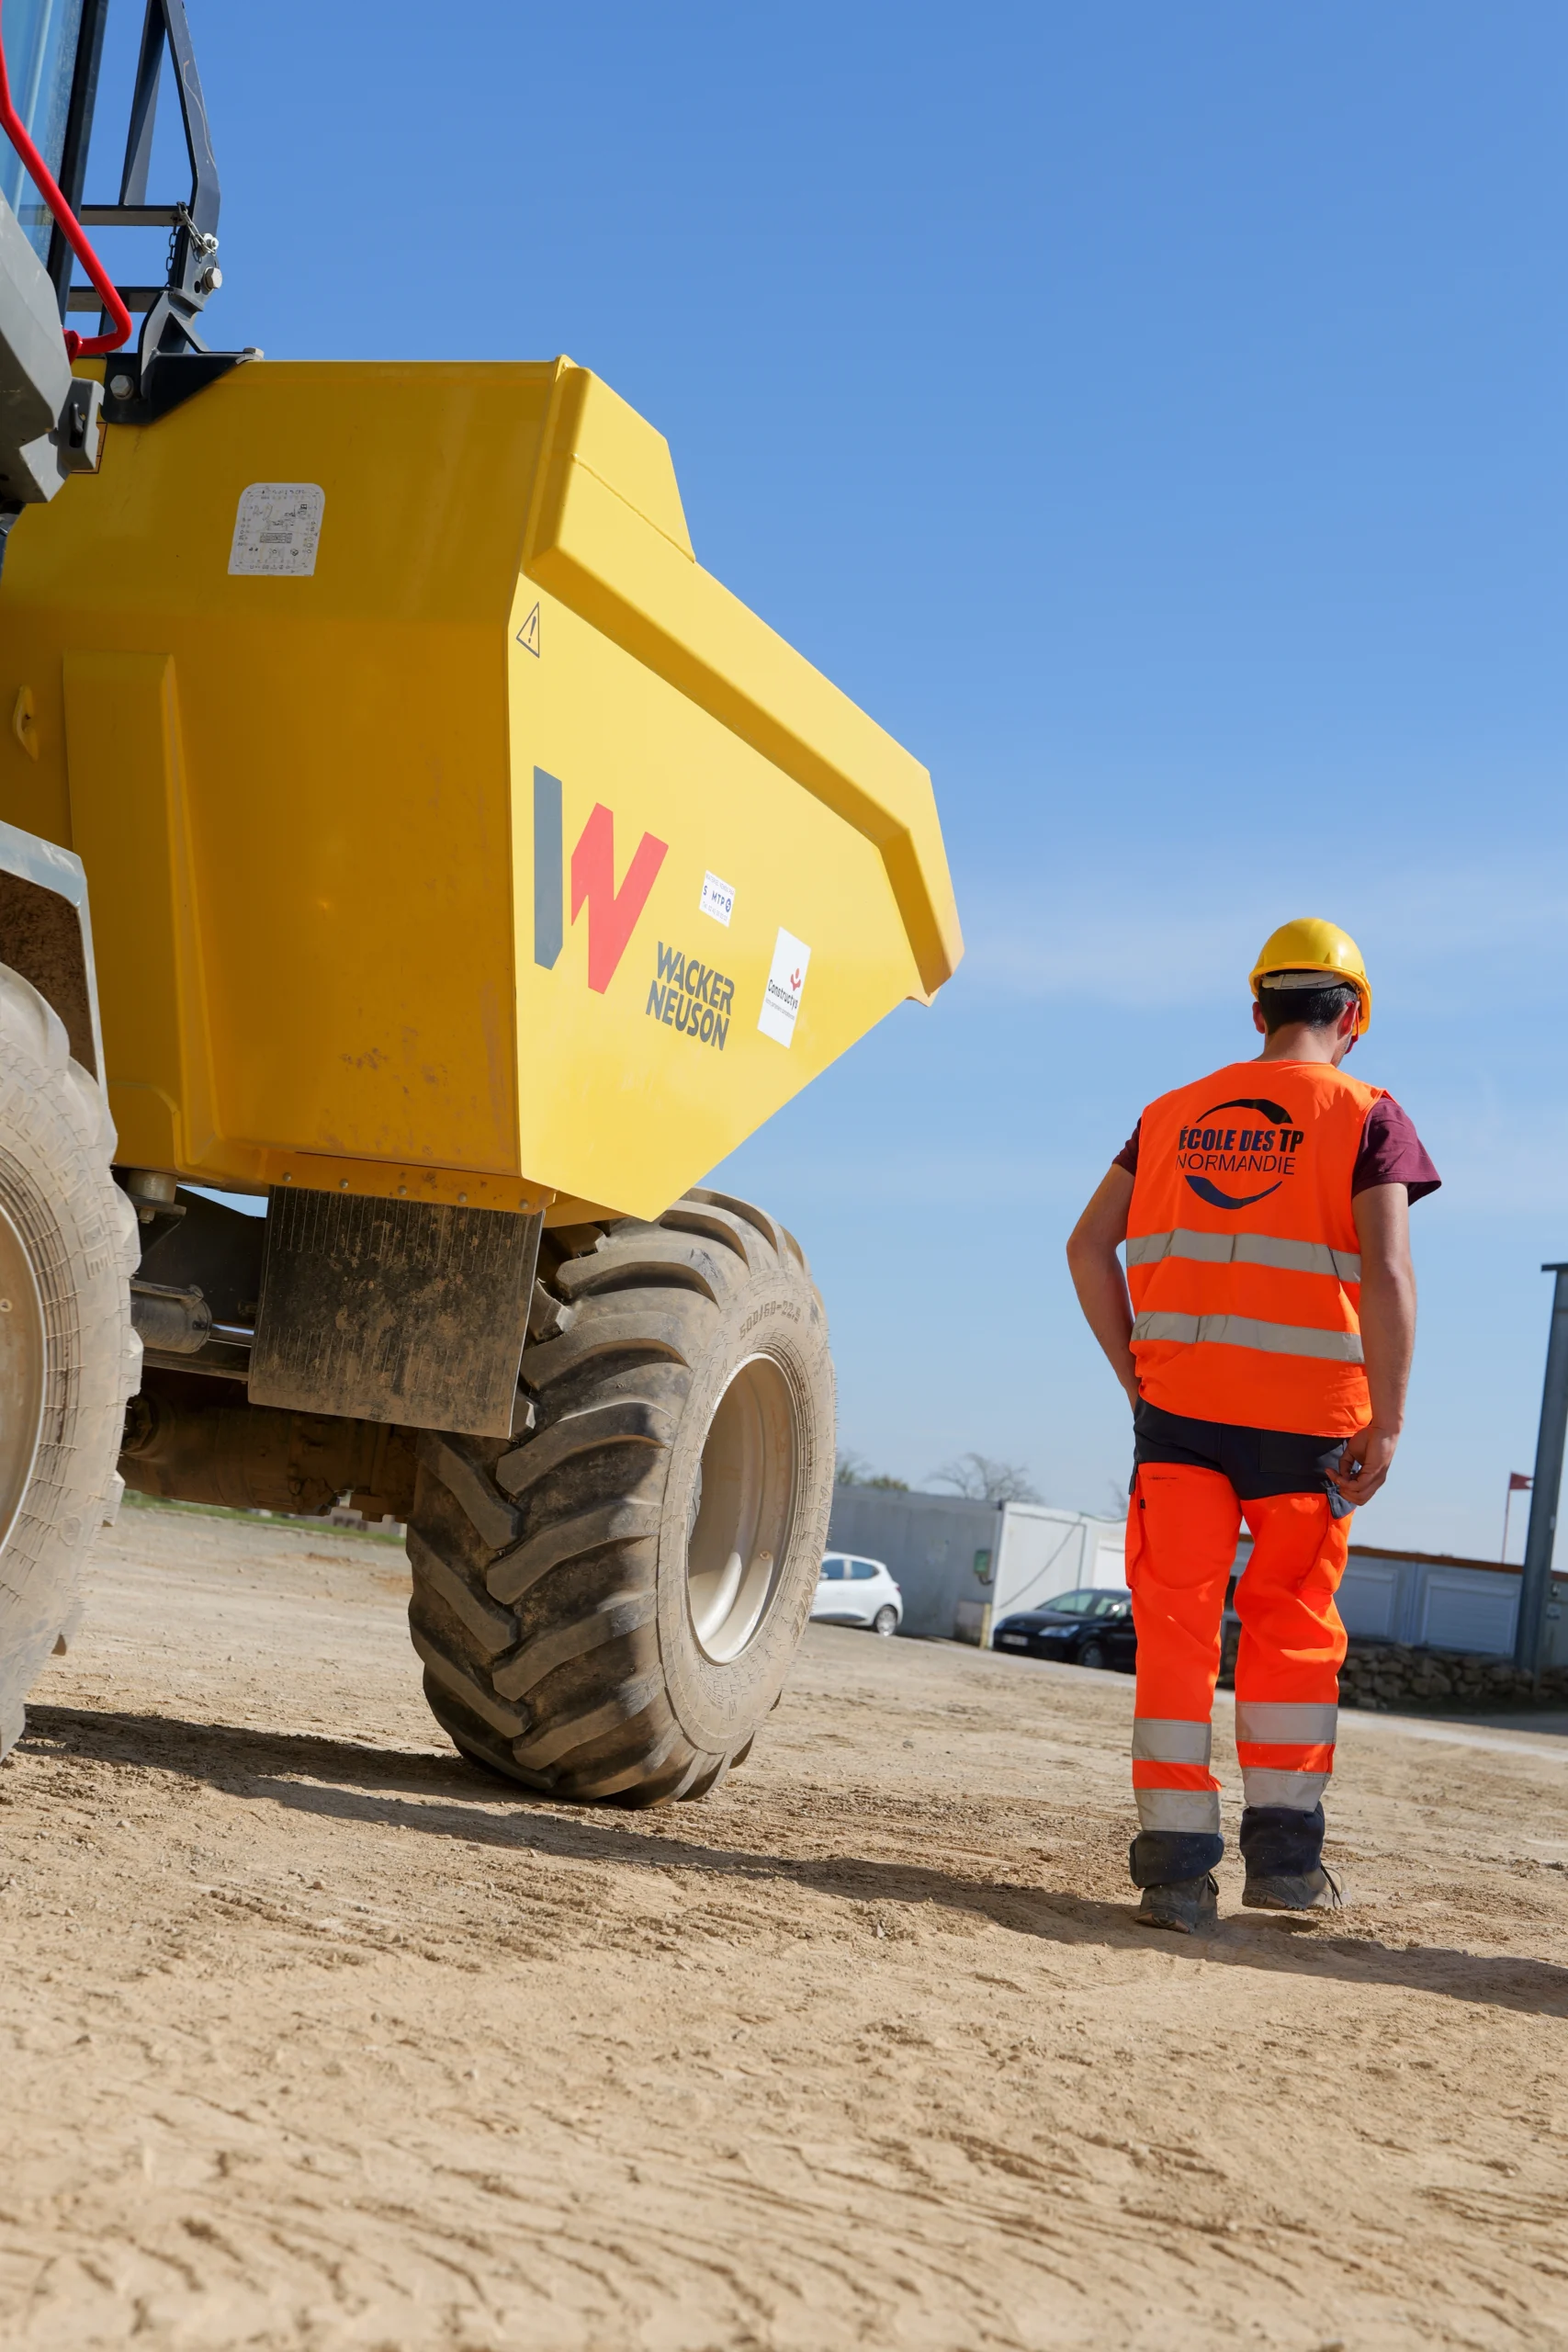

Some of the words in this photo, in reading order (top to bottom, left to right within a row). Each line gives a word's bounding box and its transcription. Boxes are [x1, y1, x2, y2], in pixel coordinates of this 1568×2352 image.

[658, 941, 735, 1016] WACKER
[768, 979, 798, 1011] Constructys
[646, 979, 729, 1051] NEUSON
[1179, 1125, 1236, 1151] ÉCOLE
[1239, 1130, 1276, 1152] DES
[1280, 1129, 1304, 1153] TP
[1176, 1153, 1296, 1175] NORMANDIE
